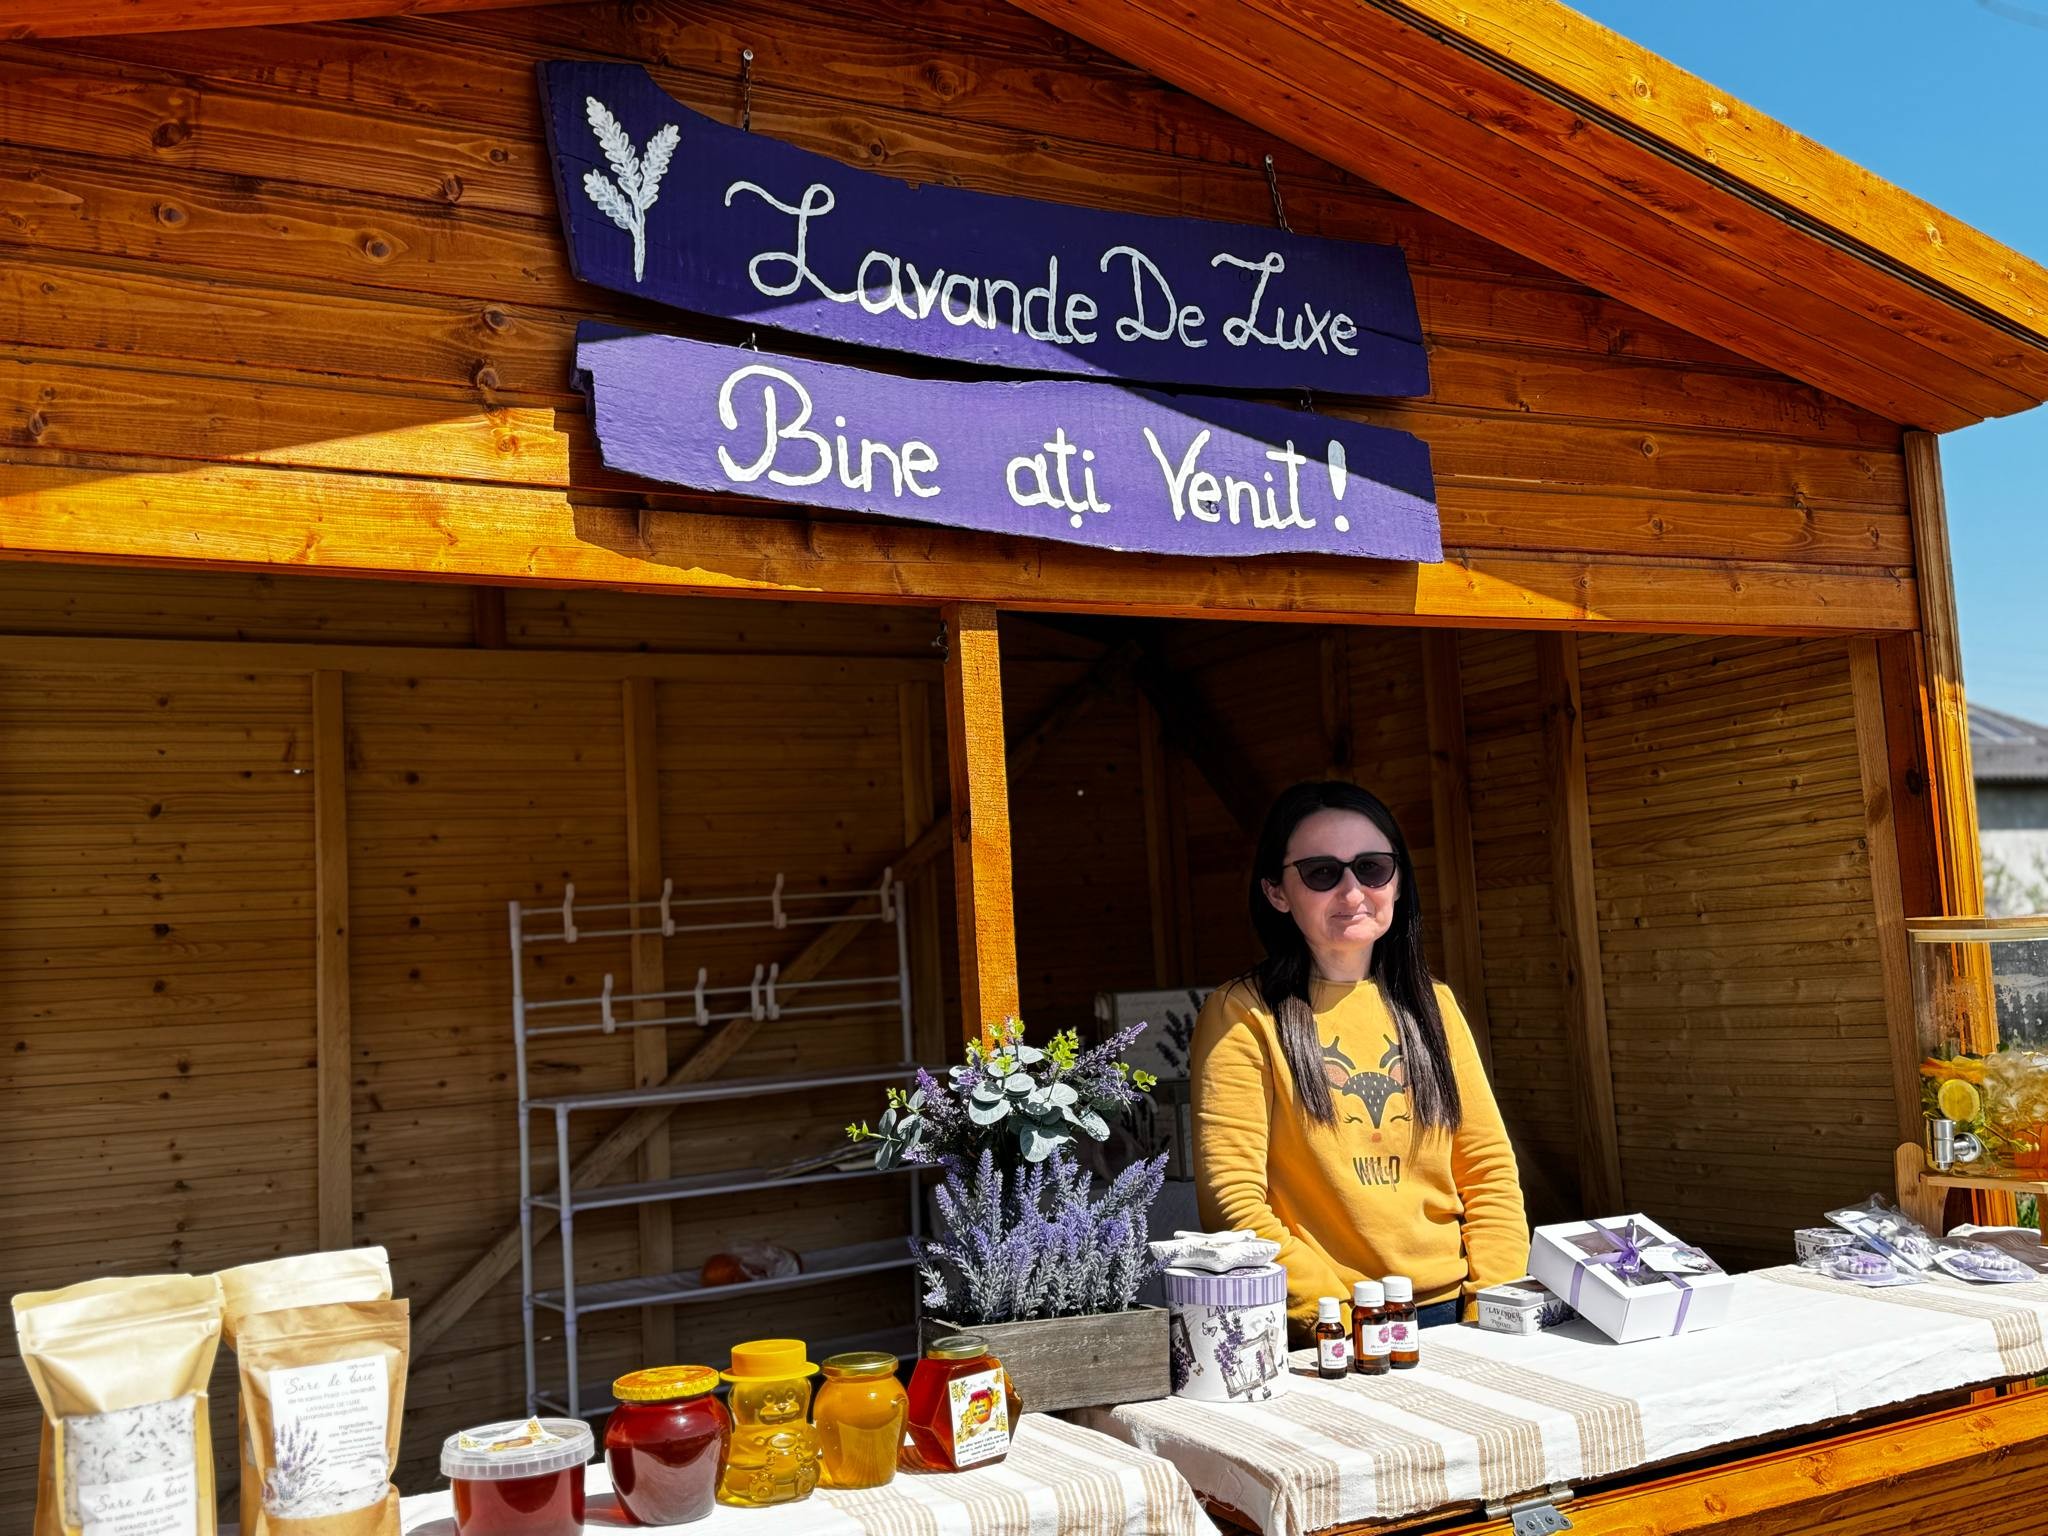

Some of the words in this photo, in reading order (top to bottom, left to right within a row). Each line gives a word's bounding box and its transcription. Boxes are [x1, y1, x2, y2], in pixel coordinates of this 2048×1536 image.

[724, 181, 1098, 344] Lavande
[1100, 245, 1208, 348] De
[1211, 252, 1358, 356] Luxe
[717, 364, 942, 498] Bine
